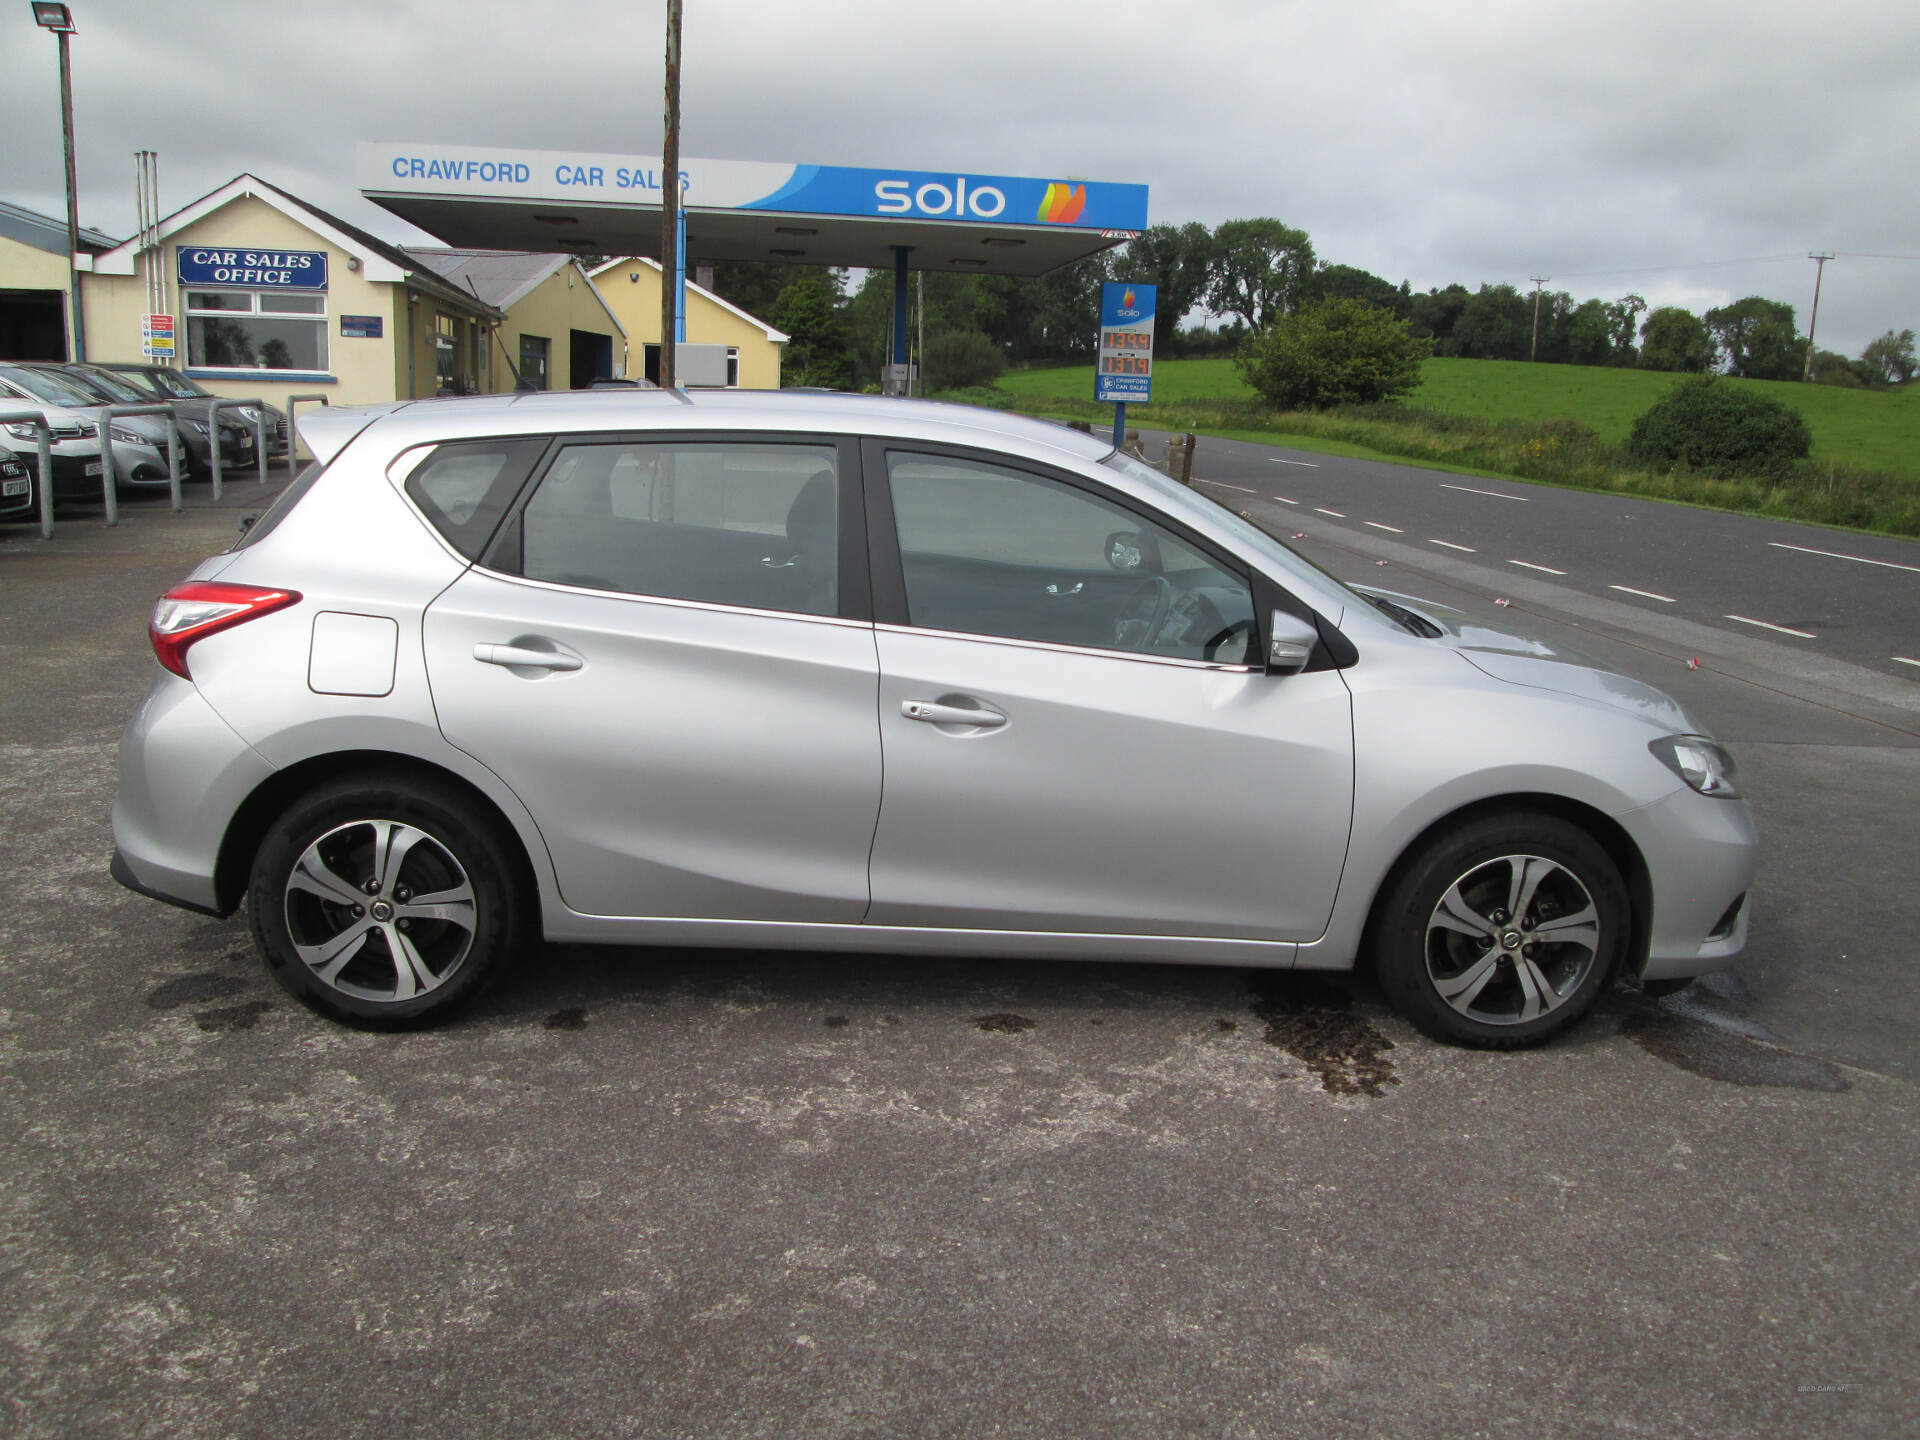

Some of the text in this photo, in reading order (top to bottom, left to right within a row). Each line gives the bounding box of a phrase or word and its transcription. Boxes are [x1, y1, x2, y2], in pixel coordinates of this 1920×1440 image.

[392, 157, 690, 191] CRAWFORD CAR SALS
[875, 178, 1006, 218] solo
[193, 252, 312, 269] CAR SALES
[214, 268, 292, 284] OFFICE
